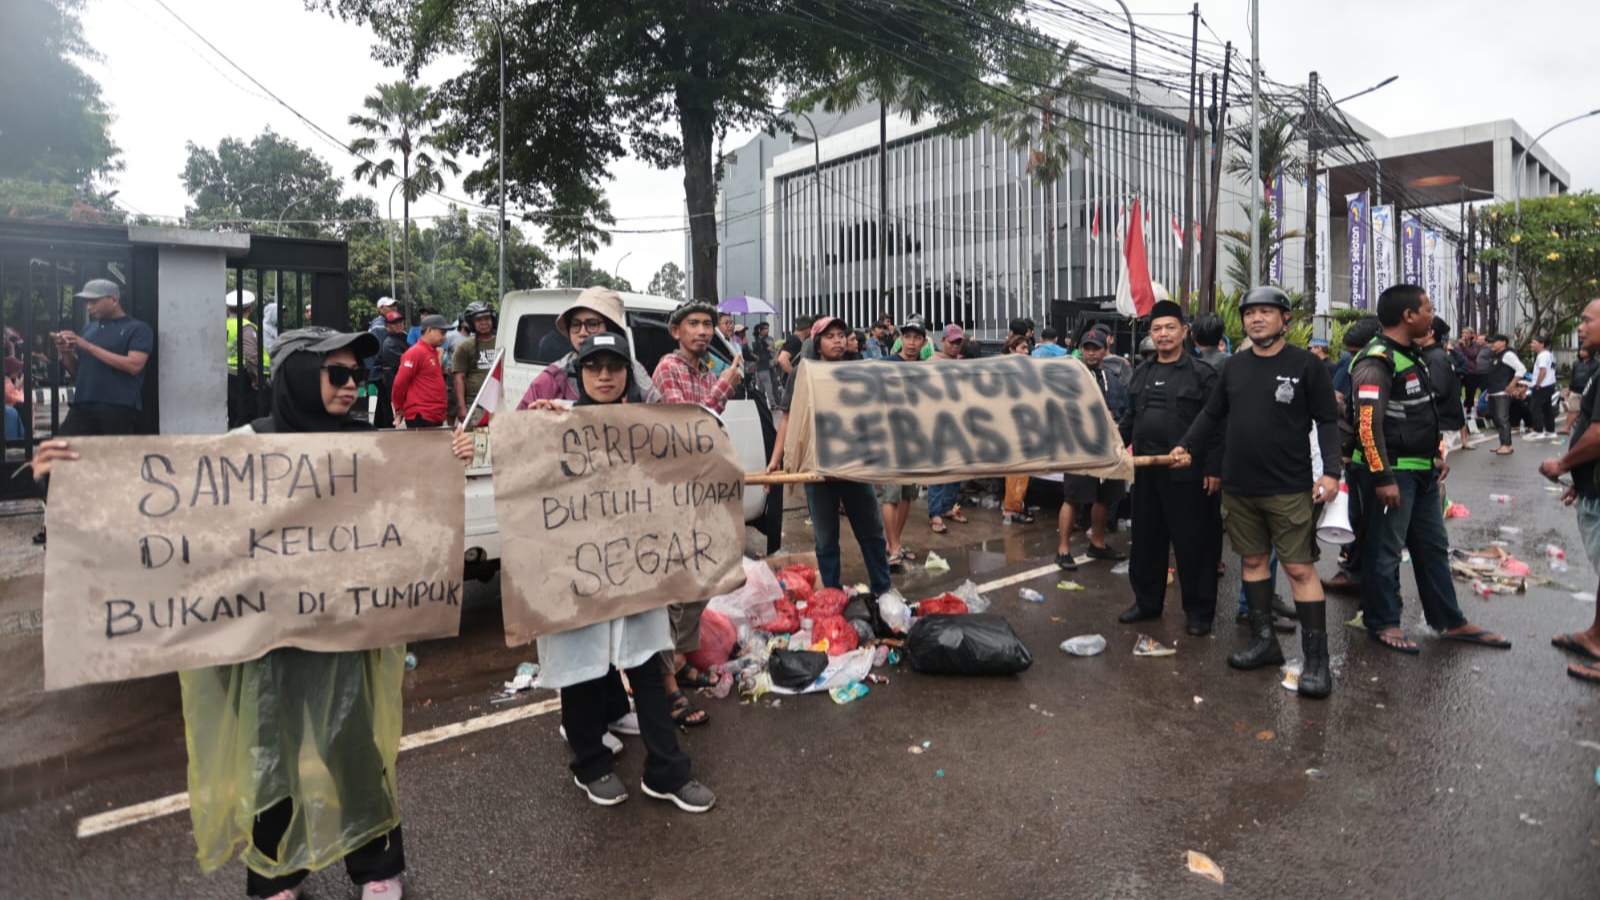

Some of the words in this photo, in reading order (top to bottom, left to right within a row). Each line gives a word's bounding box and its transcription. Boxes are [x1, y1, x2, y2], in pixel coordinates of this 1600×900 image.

[1351, 226, 1360, 263] Selatan
[1352, 264, 1361, 307] ngerang
[832, 355, 1084, 407] SERPONG
[560, 419, 715, 478] SERPONG
[814, 405, 1011, 470] BEBAS
[1010, 397, 1109, 459] BAU
[138, 452, 360, 518] SAMPAH
[542, 487, 653, 531] BUTUH
[672, 479, 742, 508] UDARA
[139, 534, 191, 570] DI
[247, 523, 403, 559] KELOLA
[569, 529, 719, 598] SEGAR
[105, 590, 267, 639] BUKAN
[297, 590, 326, 616] DI
[344, 581, 463, 616] TUMPUK
